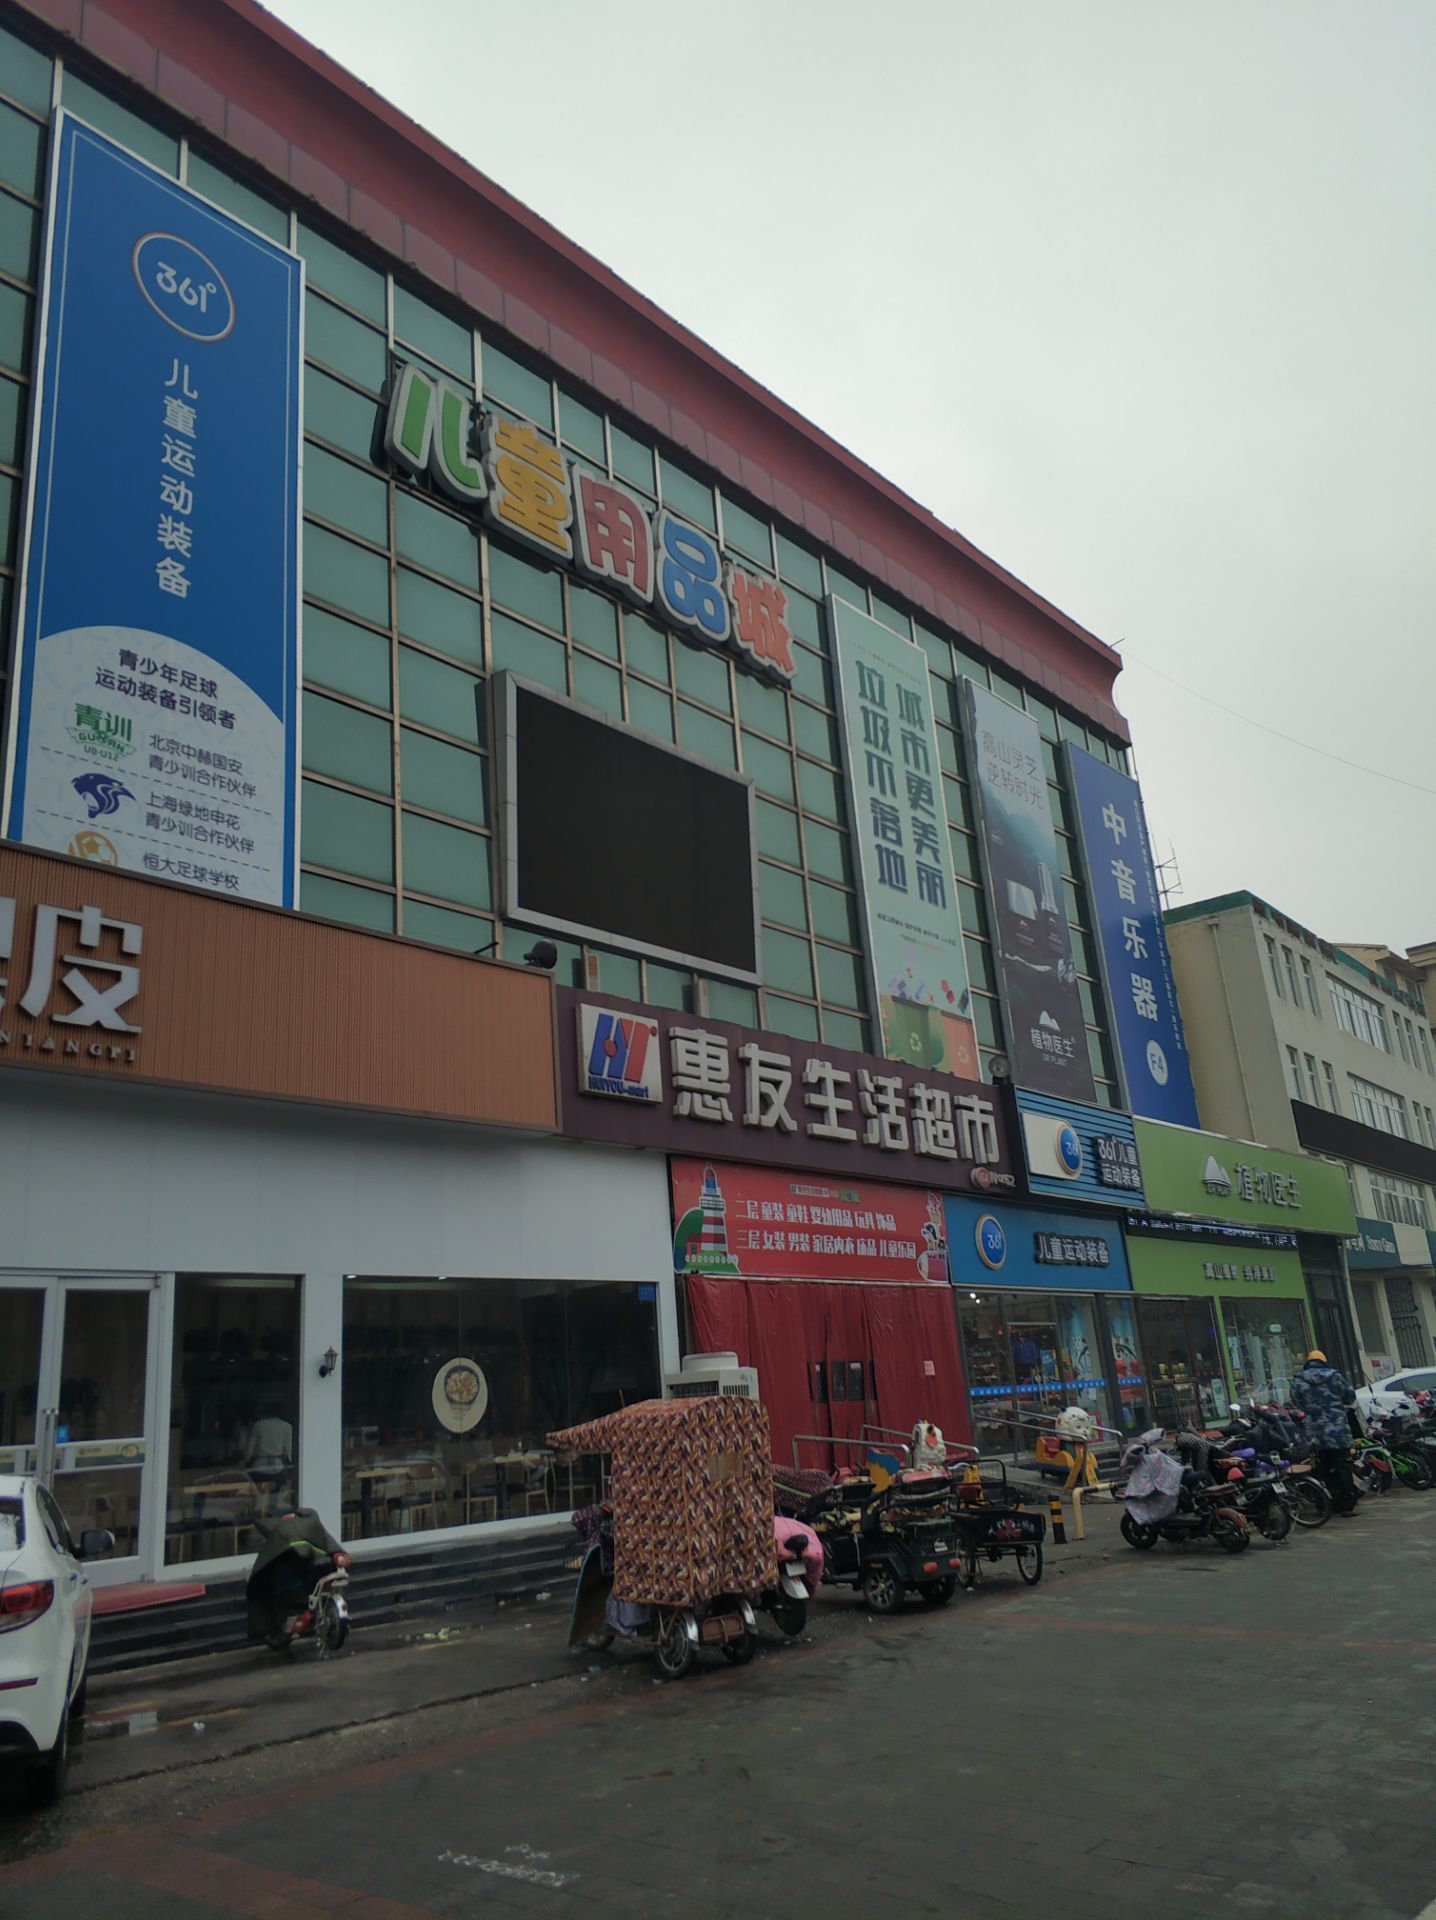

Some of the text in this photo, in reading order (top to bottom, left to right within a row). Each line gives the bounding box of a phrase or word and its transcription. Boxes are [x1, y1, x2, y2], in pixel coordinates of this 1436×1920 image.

[155, 357, 200, 599] 儿童运动装备
[390, 366, 797, 682] 儿童用品城
[118, 648, 219, 700] 青少年足球
[95, 665, 237, 731] 运动装备引领者
[74, 703, 132, 742] 青训
[148, 733, 244, 776] 北京中赫国安
[149, 754, 257, 799] 青少训合作伙伴
[855, 660, 908, 894] 垃圾不落地
[145, 791, 241, 831] 上海绿地申花
[895, 683, 947, 910] 城市更美丽
[145, 812, 255, 854] 青少训合作伙伴
[143, 852, 240, 891] 恒大足球学校
[1102, 803, 1159, 1022] 中音乐器
[1030, 1027, 1075, 1058] 植物医生
[669, 1026, 1000, 1165] 惠友生活超市
[1102, 1163, 1141, 1187] 运动装备
[1234, 1161, 1302, 1209] 植物医生
[1039, 1235, 1109, 1264] 儿童运动装备
